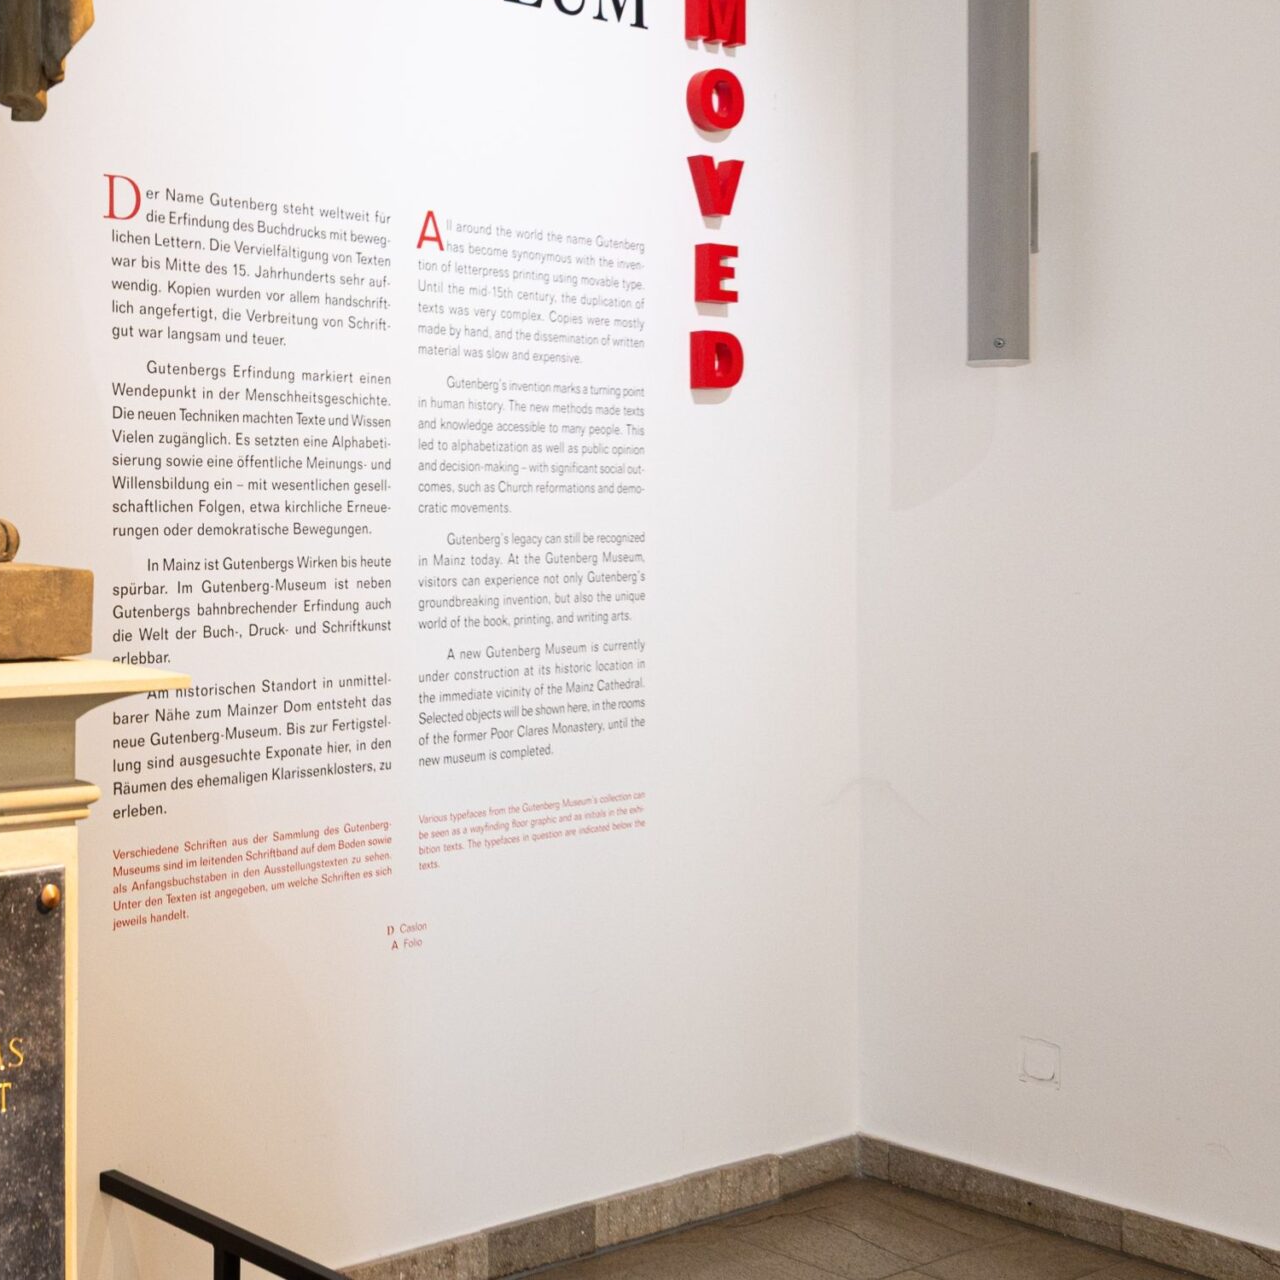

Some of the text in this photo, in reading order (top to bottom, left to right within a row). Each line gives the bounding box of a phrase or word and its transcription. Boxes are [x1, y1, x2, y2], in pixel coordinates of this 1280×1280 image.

[165, 187, 204, 204] Name
[209, 192, 277, 215] Gutenberg
[283, 202, 314, 216] steht
[319, 206, 369, 222] weltweit
[374, 209, 391, 224] für
[145, 209, 390, 248] die Erfindung des Buchdrucks mit beweg-
[111, 228, 391, 266] lichen Lettern. Die Vervielfältigung von Texten
[110, 255, 390, 288] war bis Mitte des 15. Jahrhunderts sehr auf-
[110, 278, 390, 309] wendig. Kopien wurden vor allem handschrift-
[111, 299, 390, 331] lich angefertigt, die Verbreitung von Schrift-
[111, 325, 286, 346] gut war langsam und teuer.
[417, 502, 447, 513] cratic
[511, 532, 542, 547] legacy
[544, 535, 561, 544] can
[563, 532, 580, 544] still
[582, 532, 594, 544] be
[596, 531, 645, 546] recognized
[146, 554, 392, 572] In Mainz ist Gutenbergs Wirken bis heute
[417, 554, 428, 566] in
[432, 553, 465, 566] Mainz
[507, 552, 519, 565] At
[523, 552, 540, 565] the
[544, 551, 598, 566] Gutenberg
[177, 580, 193, 594] Im
[201, 578, 326, 595] Gutenberg-Museum
[334, 578, 348, 590] ist
[356, 576, 391, 589] neben
[111, 597, 392, 620] Gutenbergs bahnbrechender Erfindung auch
[111, 619, 391, 642] die Welt der Buch-, Druck- und Schriftkunst
[446, 638, 645, 659] A new Gutenberg Museum is currently
[112, 694, 392, 725] barer Nähe zum Mainzer Dom entsteht das
[112, 715, 391, 749] neue Gutenberg-Museum. Bis zur Fertigstel-
[418, 756, 440, 767] new
[442, 752, 486, 764] museum
[488, 749, 497, 760] is
[112, 761, 392, 795] Räumen des ehemaligen Klarissenklosters, zu
[111, 844, 179, 859] Verschiedene
[183, 838, 227, 852] Schriften
[231, 837, 248, 846] aus
[252, 833, 267, 844] der
[272, 828, 319, 842] Sammlung
[323, 825, 339, 836] des
[112, 914, 147, 931] jeweils
